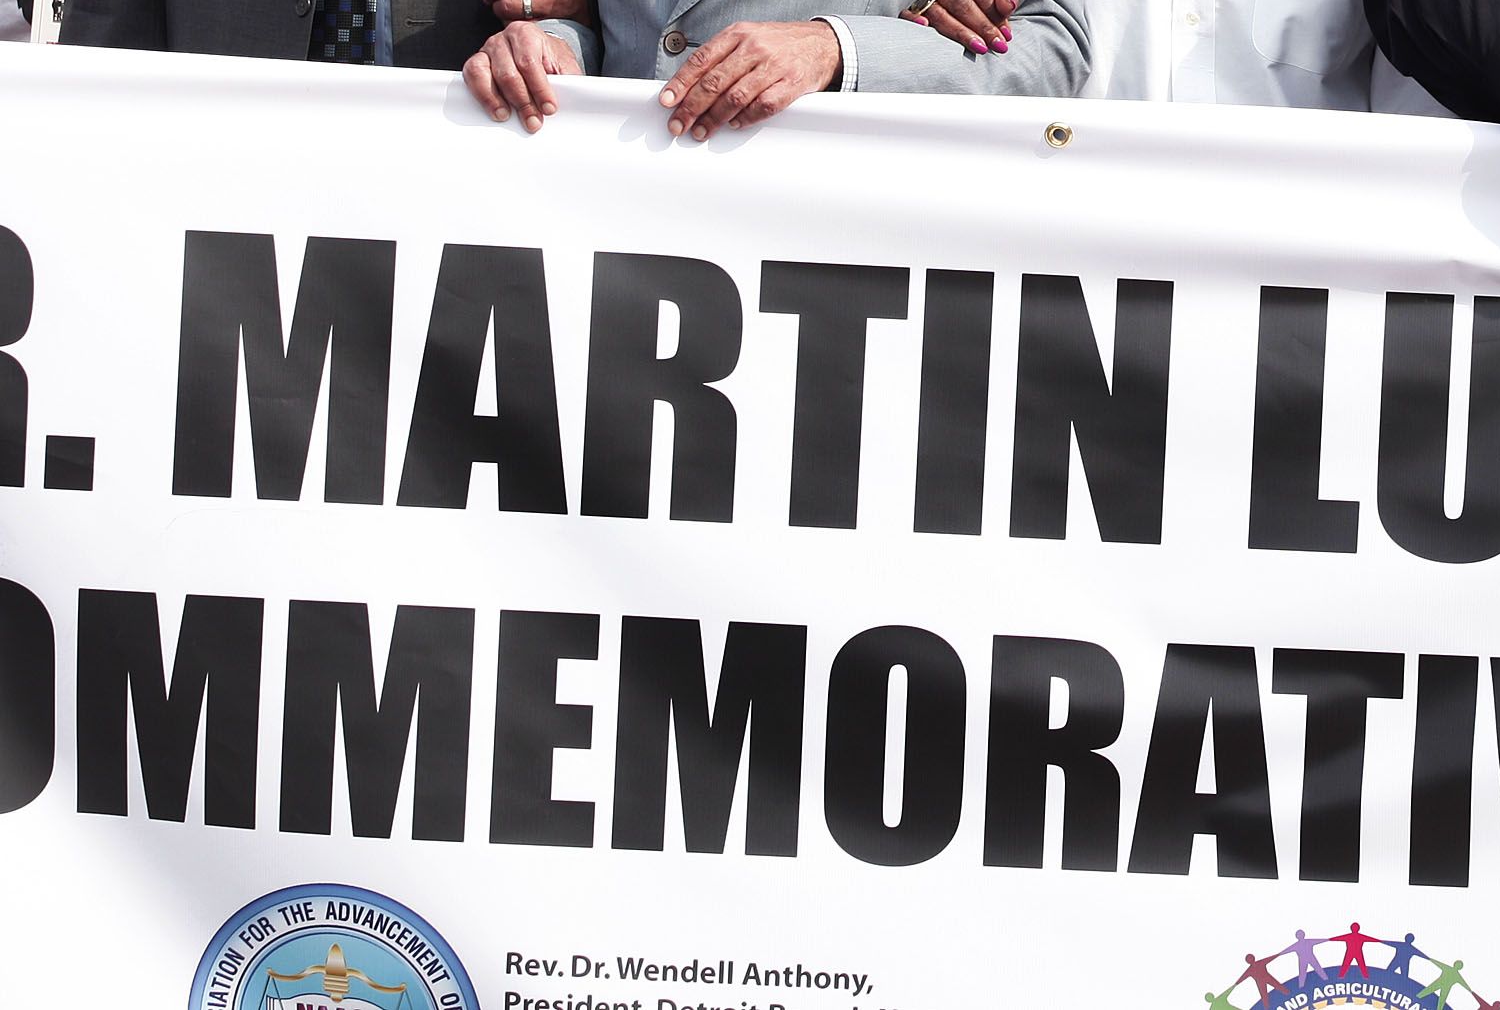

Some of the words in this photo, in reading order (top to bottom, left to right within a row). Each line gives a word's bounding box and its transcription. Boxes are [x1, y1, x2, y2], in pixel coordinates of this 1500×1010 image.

[172, 230, 1174, 546] MARTIN
[207, 947, 246, 1010] IATION
[238, 916, 276, 950] FOR
[278, 901, 315, 926] THE
[325, 900, 451, 985] ADVANCEMENT
[505, 951, 564, 977] Rev.
[571, 954, 611, 980] Dr.
[616, 956, 734, 986] Wendell
[742, 962, 874, 997] Anthony,
[1313, 982, 1428, 1010] AGRICULTURA
